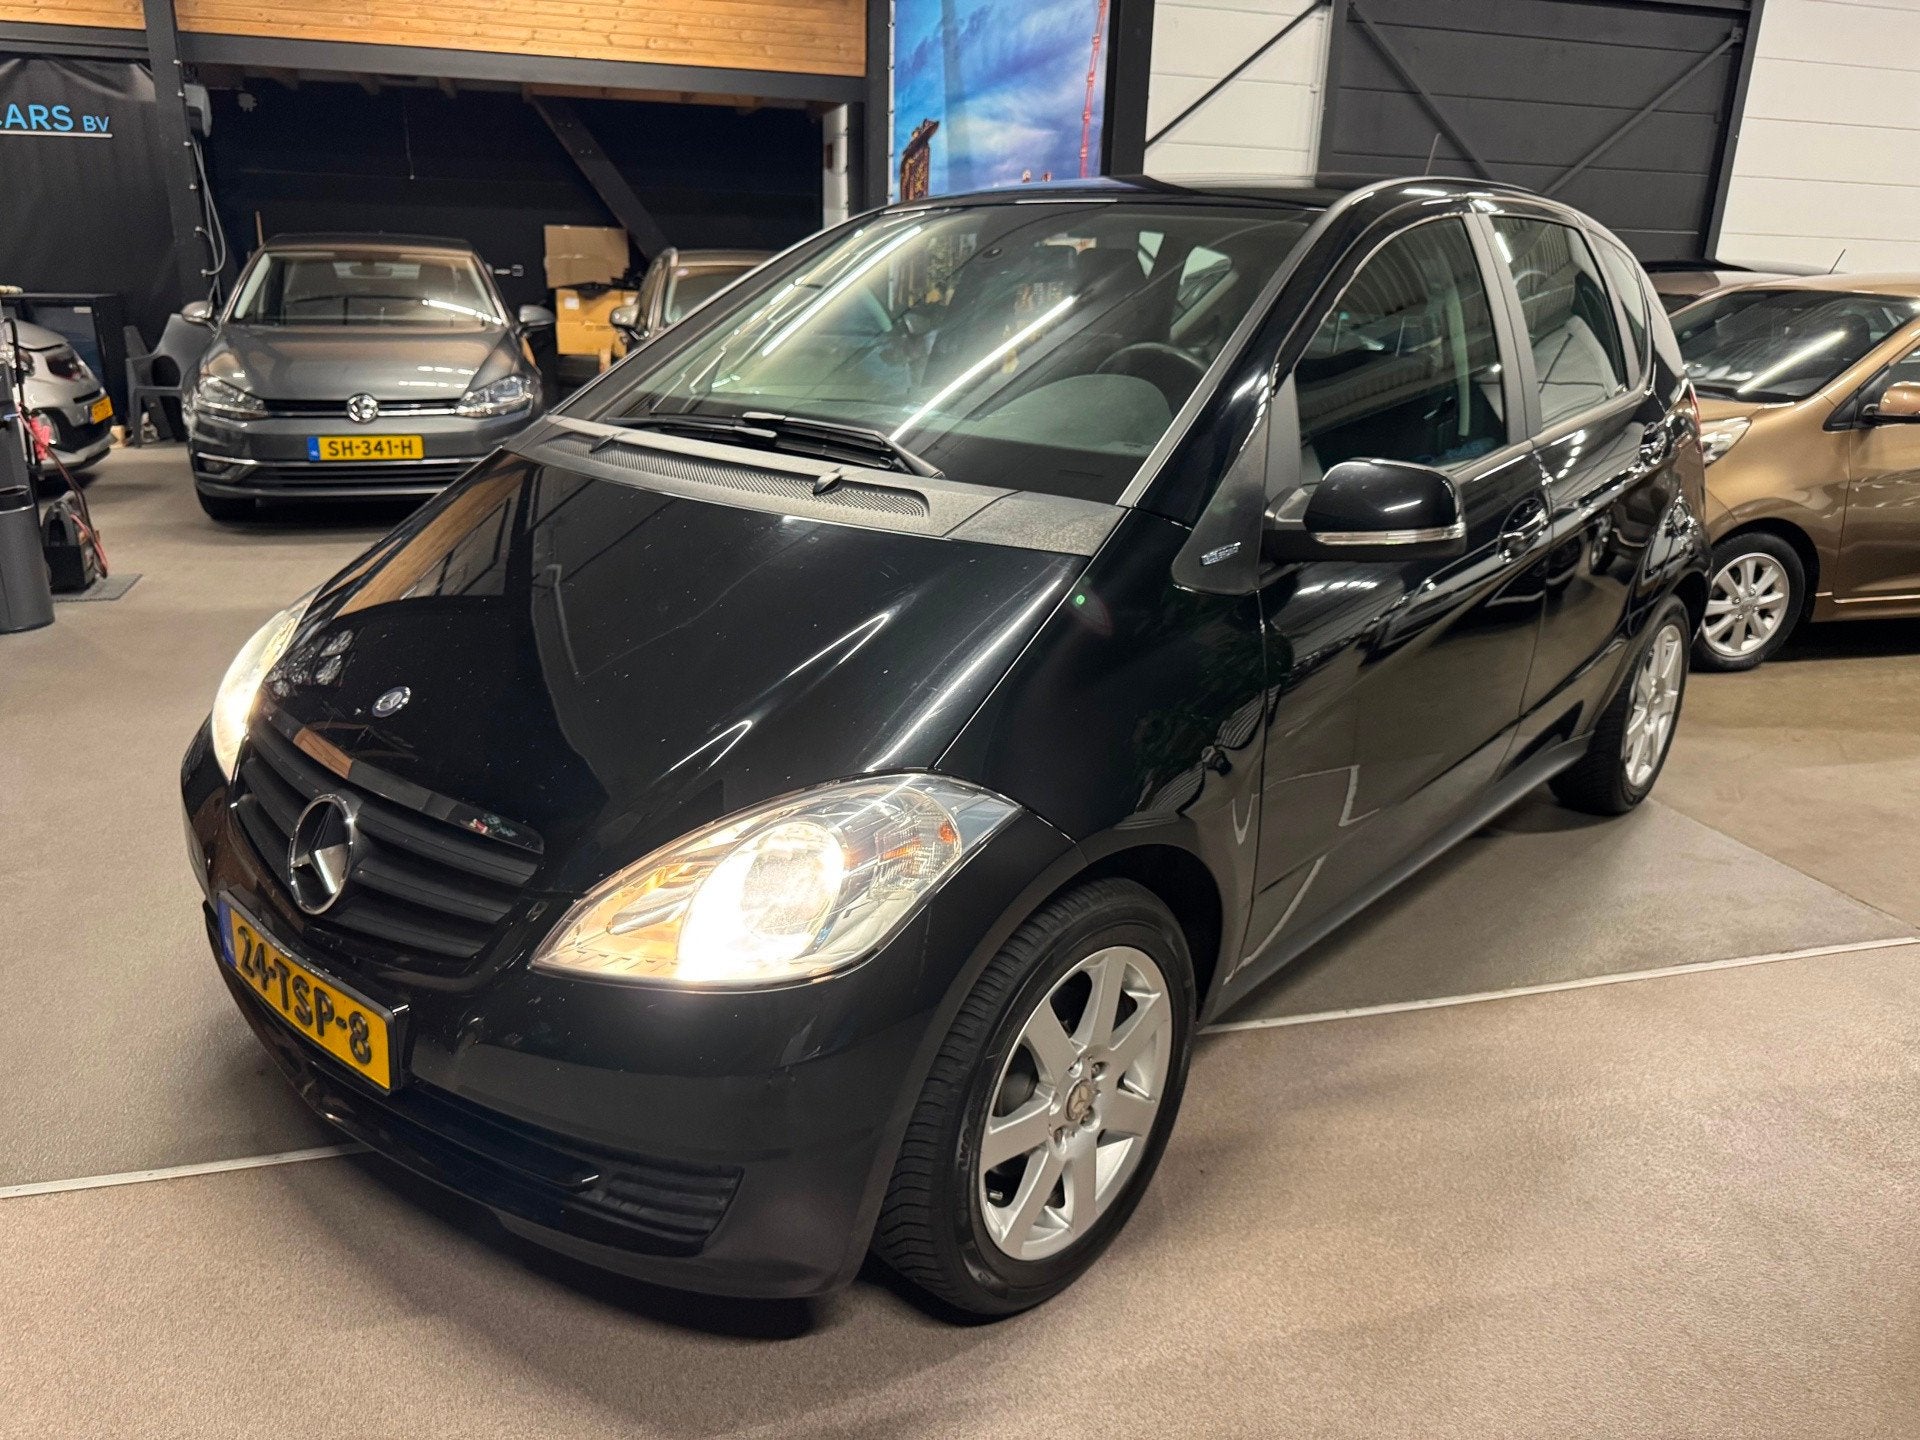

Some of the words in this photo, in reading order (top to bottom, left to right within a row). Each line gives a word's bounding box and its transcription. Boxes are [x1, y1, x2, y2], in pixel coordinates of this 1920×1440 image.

[0, 103, 74, 132] ARS
[82, 115, 110, 132] BV
[327, 440, 413, 457] SH-341-H
[237, 925, 372, 1065] 24-TSP-8
